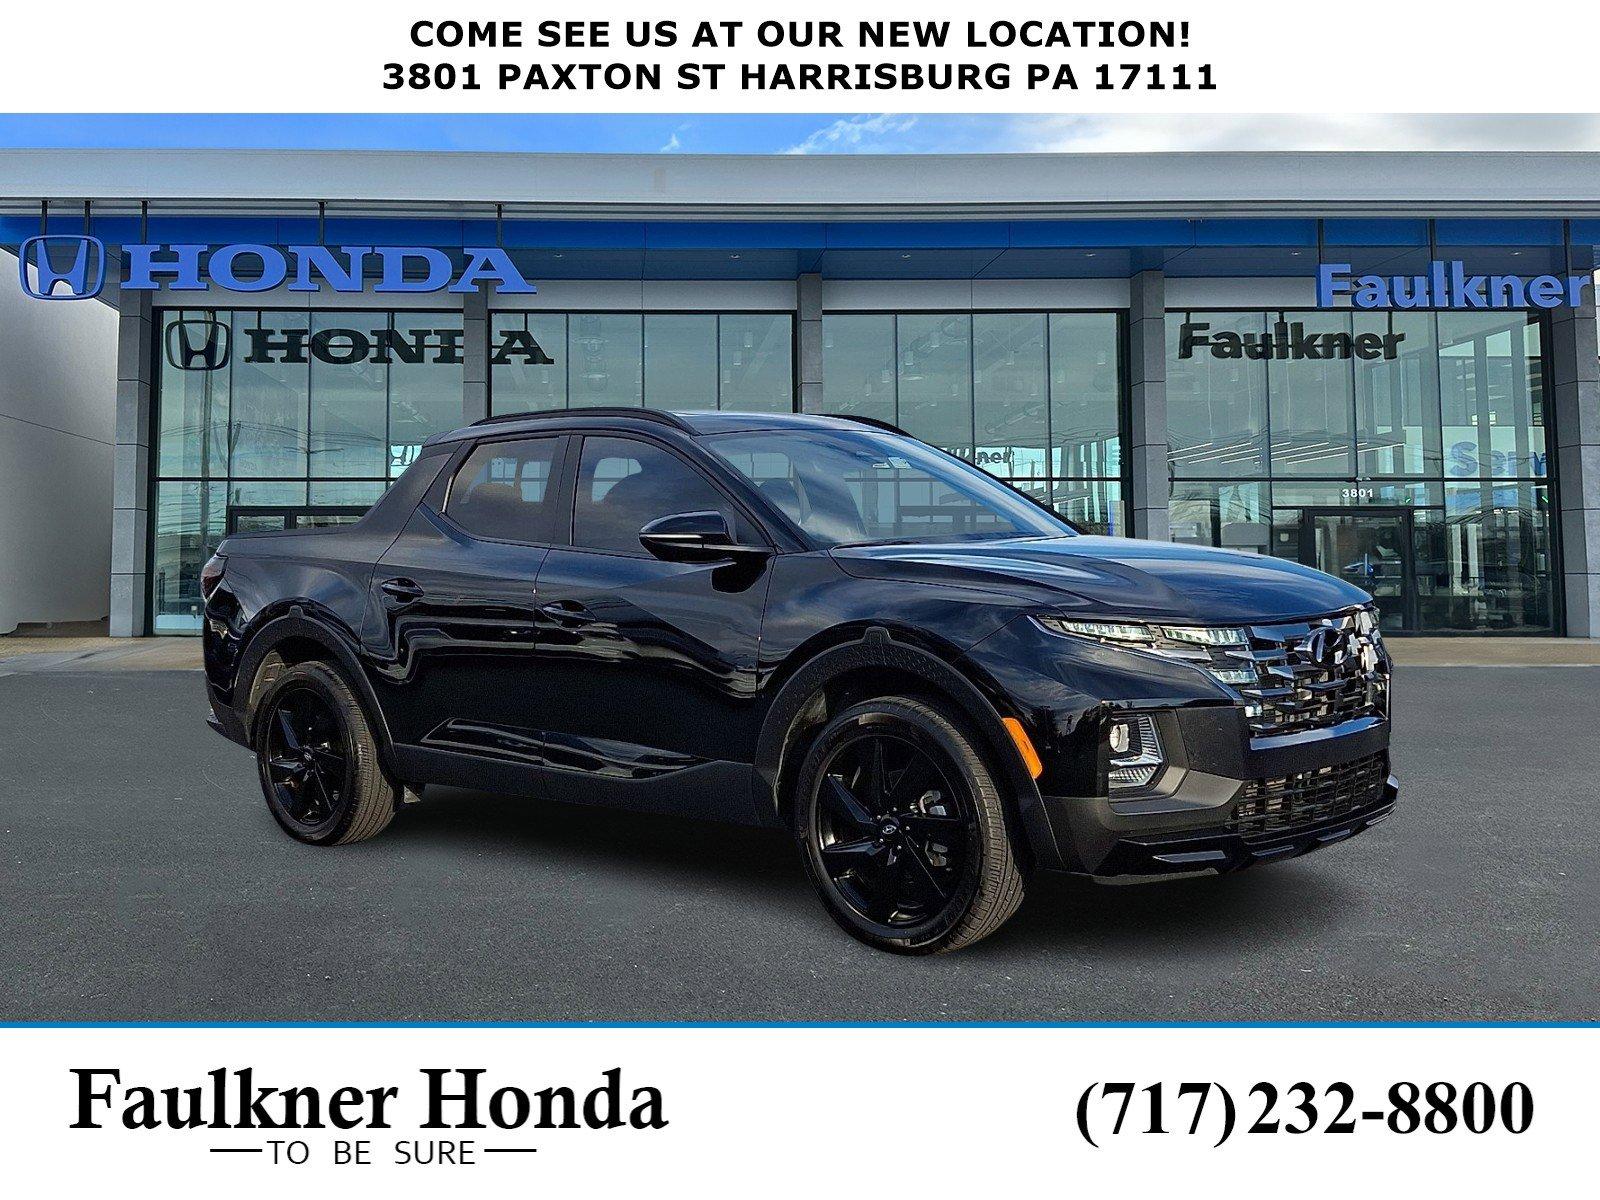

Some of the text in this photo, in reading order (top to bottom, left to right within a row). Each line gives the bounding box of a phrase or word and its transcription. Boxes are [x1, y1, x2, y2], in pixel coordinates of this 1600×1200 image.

[119, 243, 538, 295] HONDA
[1315, 260, 1593, 309] Faulkner
[1178, 322, 1407, 360] Faulkner
[1341, 488, 1374, 498] 3801
